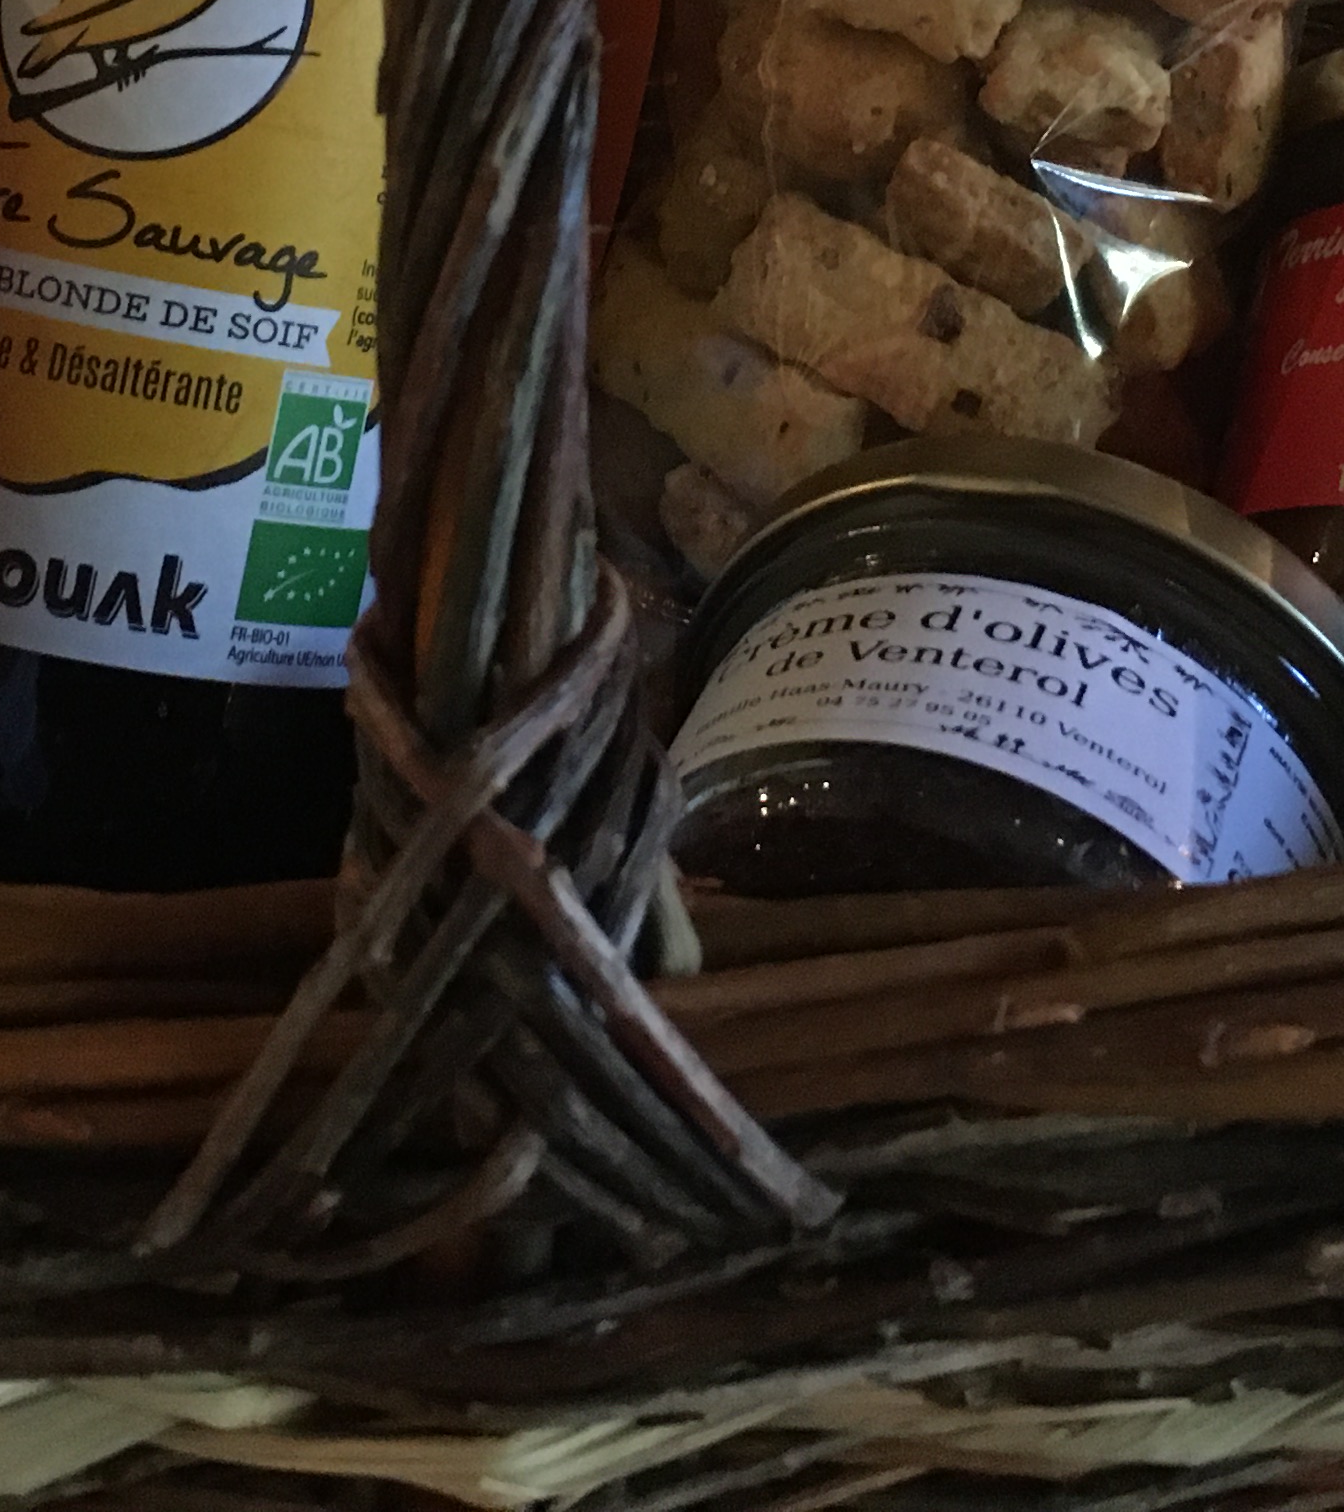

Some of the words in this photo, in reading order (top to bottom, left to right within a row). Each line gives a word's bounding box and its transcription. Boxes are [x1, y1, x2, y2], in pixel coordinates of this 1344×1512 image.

[47, 168, 328, 313] Sauvage
[159, 299, 219, 336] DE
[227, 311, 320, 350] SOIF
[18, 337, 40, 376] &
[47, 341, 244, 416] Désaltérante
[273, 424, 345, 485] AB
[259, 500, 346, 520] BIOLOGIQUE
[262, 485, 350, 505] AGRICULTURE
[227, 644, 295, 666] Agriculture
[230, 625, 290, 645] FR-BIO-01
[919, 604, 1180, 719] d'olives
[766, 650, 825, 678] de
[849, 638, 1090, 710] Venterol
[958, 688, 1049, 727] 26110
[1057, 719, 1168, 796] Venterol
